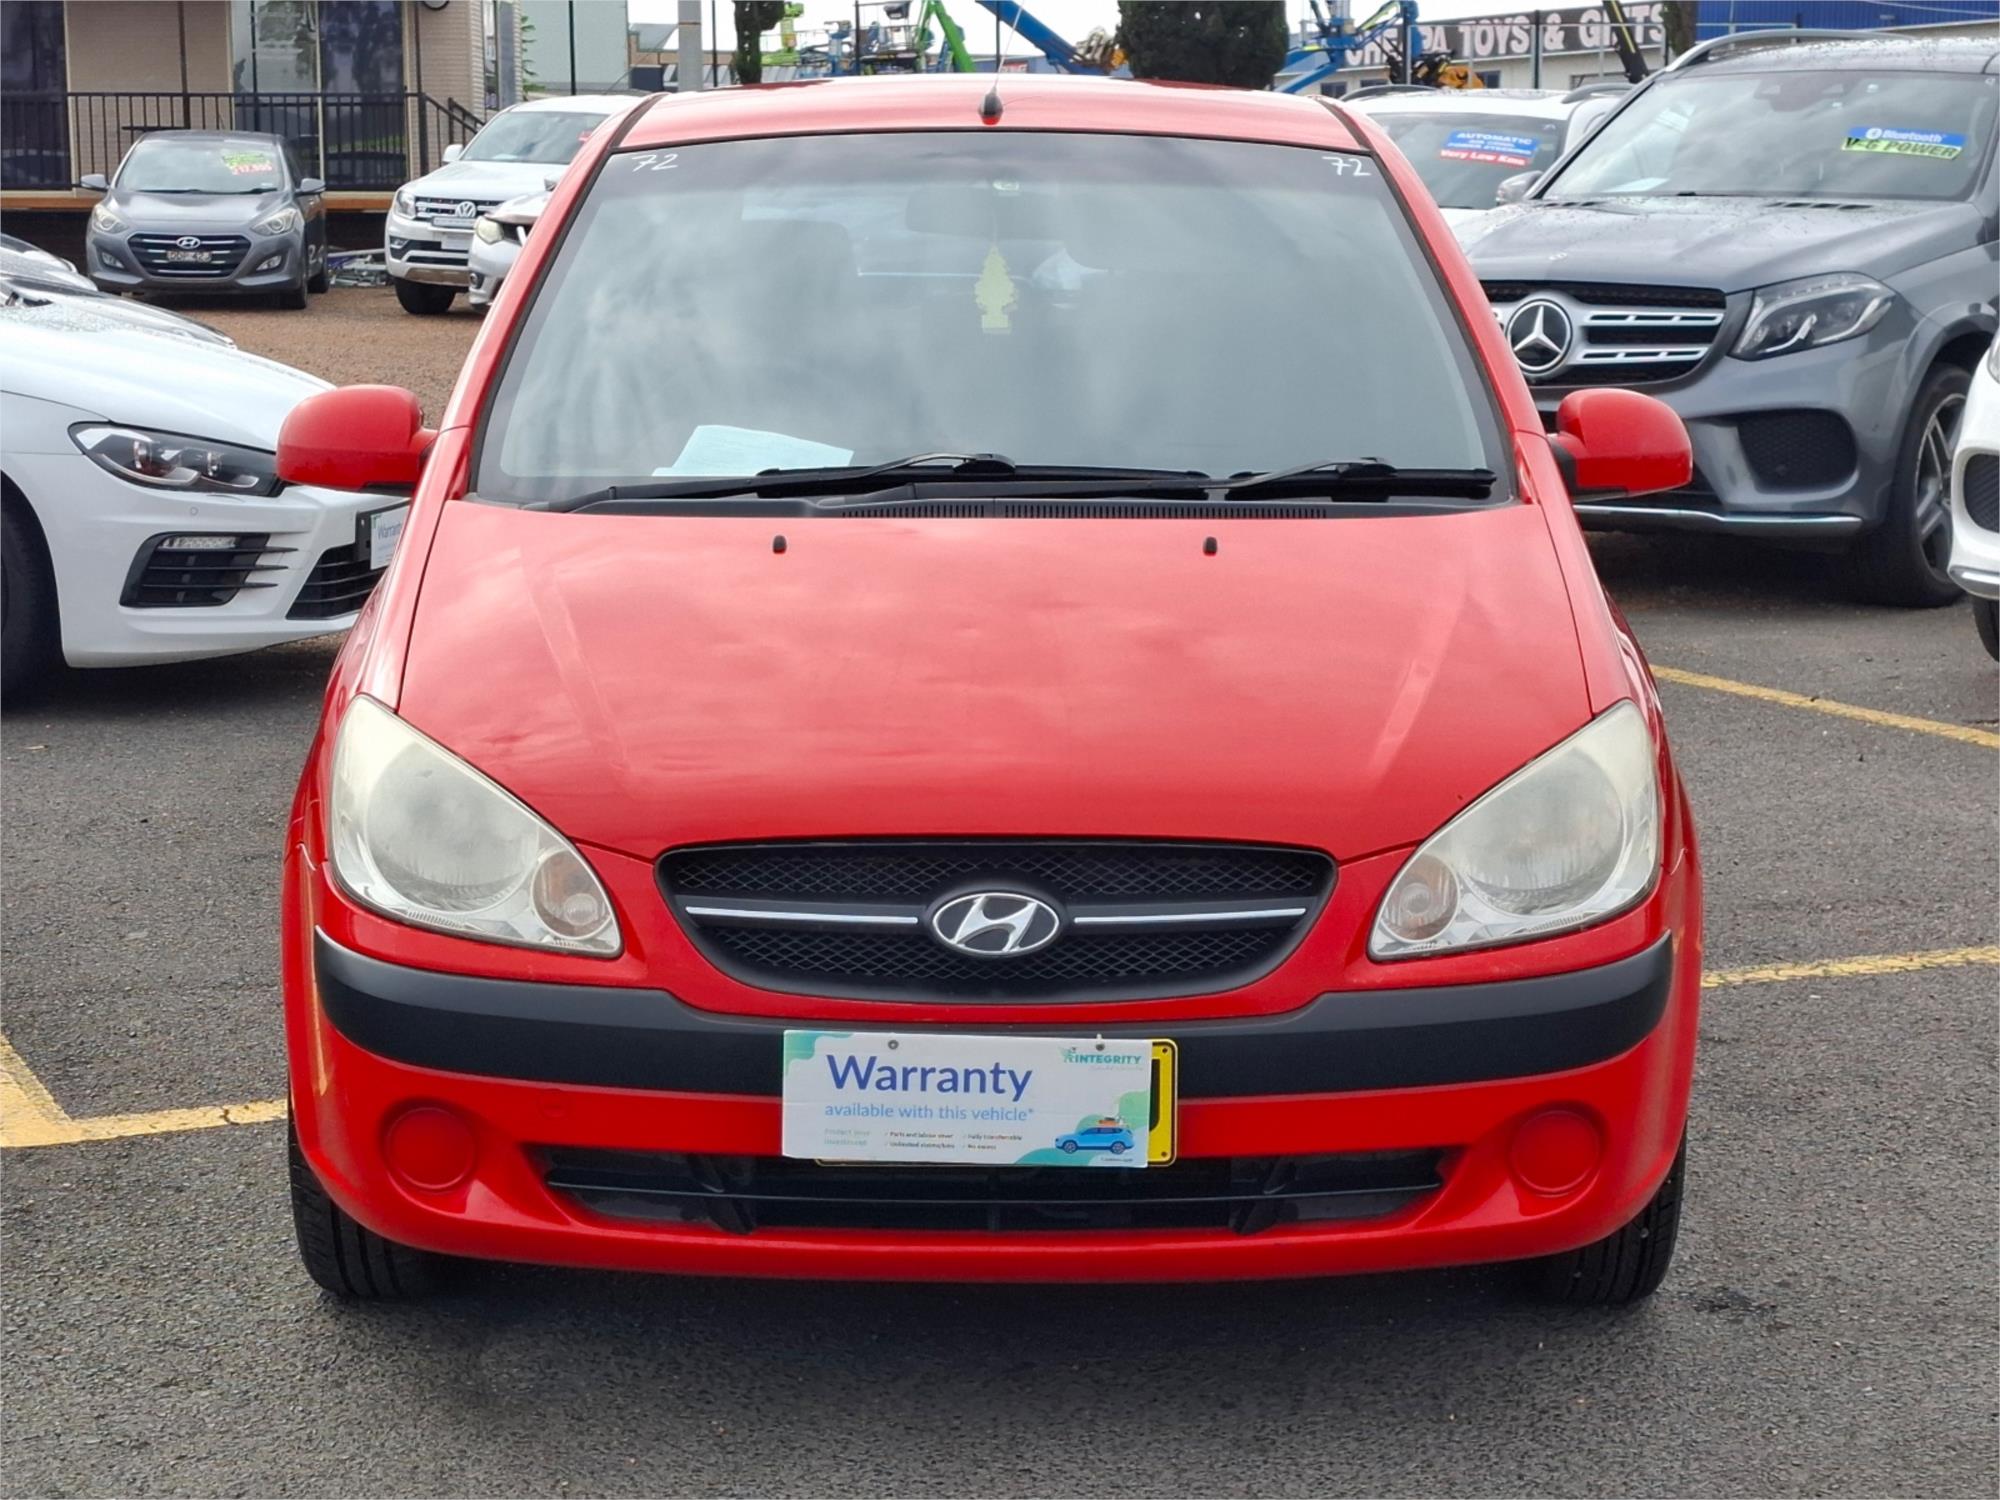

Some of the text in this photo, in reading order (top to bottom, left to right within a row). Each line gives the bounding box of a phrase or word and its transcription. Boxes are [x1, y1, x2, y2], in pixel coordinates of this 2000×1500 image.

[1458, 16, 1531, 58] TOYS
[1544, 13, 1566, 51] &
[1456, 132, 1533, 145] AUTOMATIC
[1440, 149, 1469, 160] Very
[1469, 152, 1498, 161] Low
[1883, 140, 1958, 157] POWER
[631, 153, 679, 172] 72
[1321, 156, 1372, 177] 72
[1074, 1054, 1142, 1065] INTEGRITY
[826, 1054, 1032, 1102] Warranty
[825, 1103, 894, 1117] available
[898, 1105, 933, 1118] with
[939, 1106, 967, 1119] this
